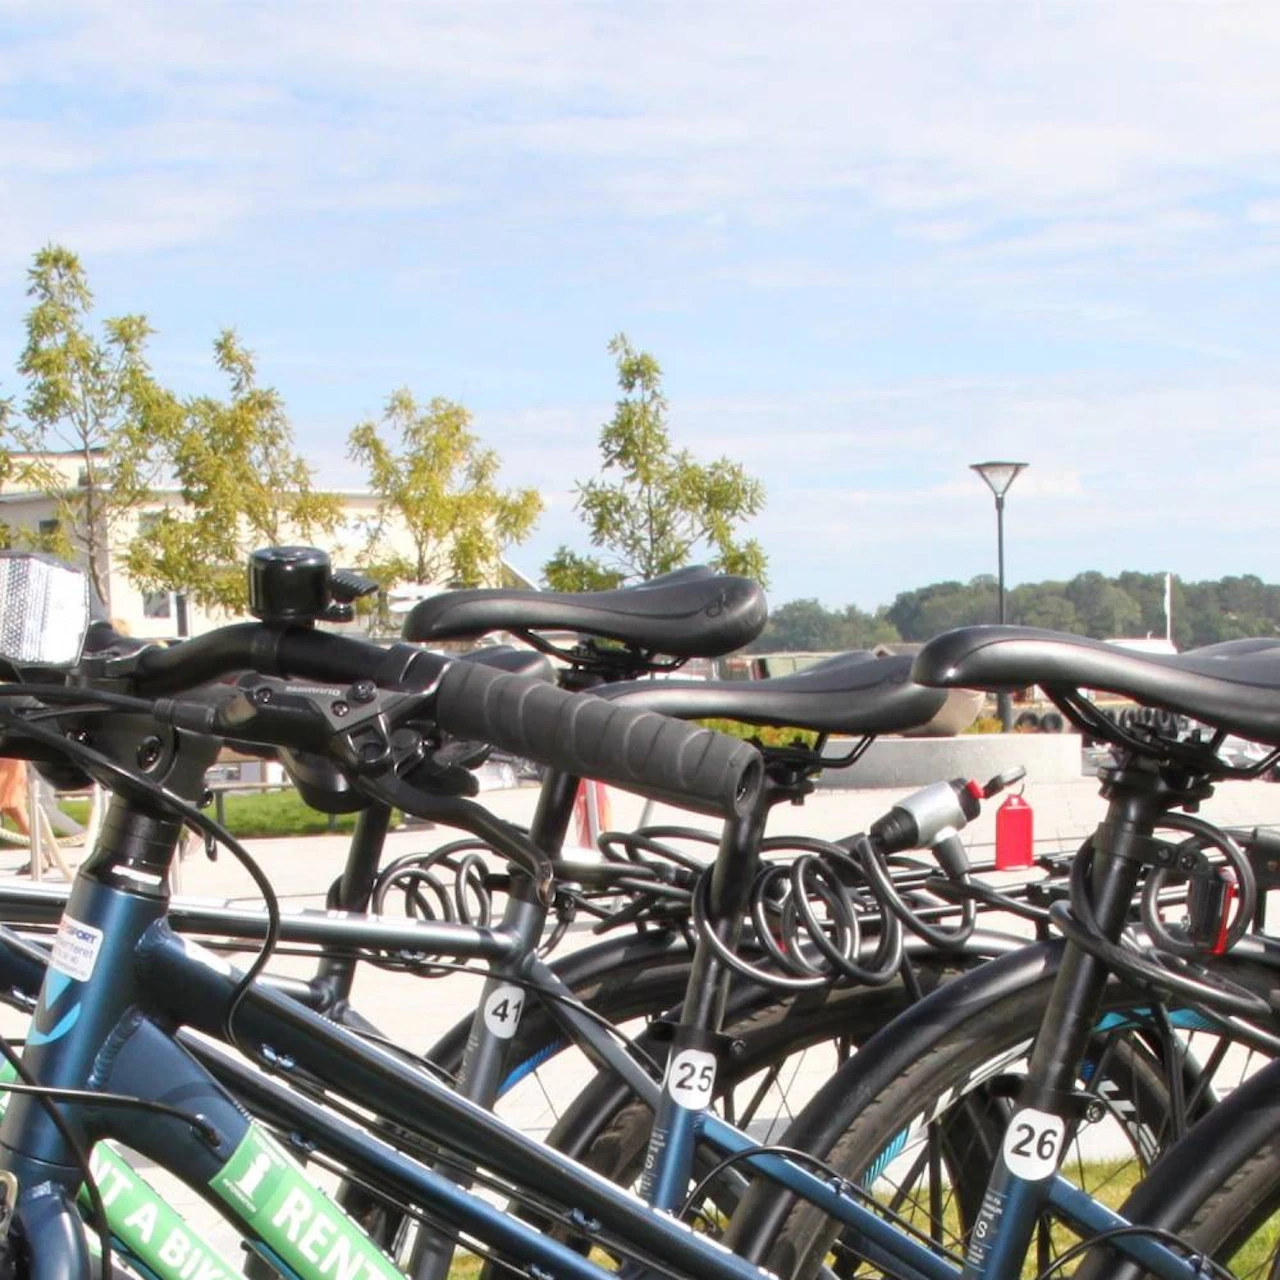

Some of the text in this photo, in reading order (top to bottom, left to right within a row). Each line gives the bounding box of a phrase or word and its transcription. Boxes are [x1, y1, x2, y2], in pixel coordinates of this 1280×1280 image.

[492, 998, 522, 1023] 41
[675, 1062, 714, 1094] 25
[1010, 1123, 1059, 1162] 26
[124, 1202, 160, 1243] A
